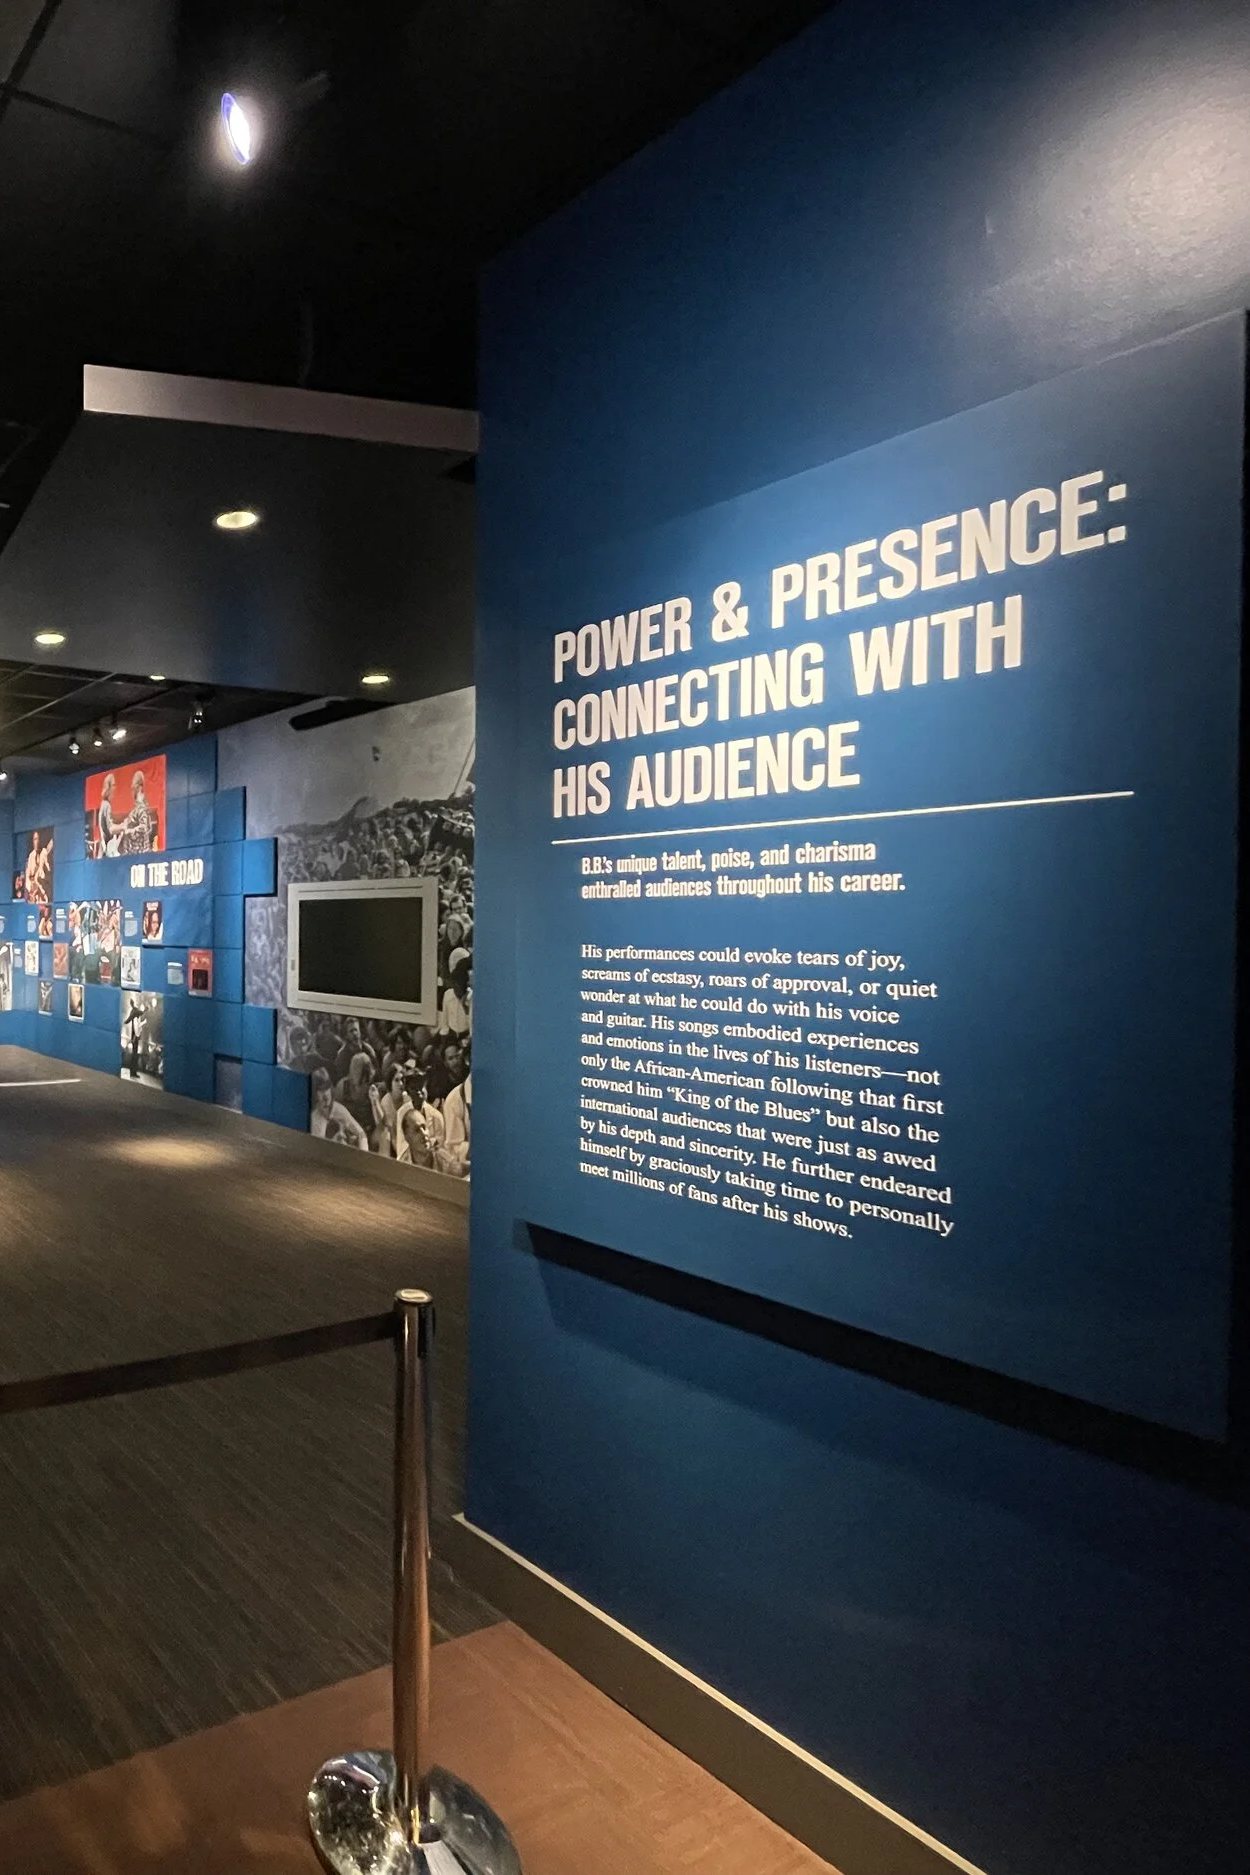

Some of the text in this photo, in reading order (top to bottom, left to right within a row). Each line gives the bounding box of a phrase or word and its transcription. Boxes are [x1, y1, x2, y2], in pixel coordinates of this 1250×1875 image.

[554, 470, 1128, 683] POWER & PRESENCE:
[554, 594, 1024, 750] CONNECTING WITH
[553, 721, 861, 818] HIS AUDIENCE
[131, 858, 204, 888] ON THE ROAD
[580, 872, 906, 899] enthralled audiences throughout his career.
[616, 854, 657, 874] unique
[661, 850, 706, 871] talent,
[711, 848, 754, 871] poise,
[760, 844, 789, 866] and
[795, 841, 876, 863] charisma
[582, 944, 905, 972] His performances could evoke tears of joy,
[582, 968, 938, 1000] screams of ecstasy, roars of approval, or quiet
[580, 989, 900, 1024] wonder at what he could do with his voice
[580, 1010, 919, 1055] and guitar. His songs embodied experiences
[580, 1032, 603, 1045] and
[606, 1036, 664, 1052] emotions
[668, 1040, 682, 1055] in
[686, 1042, 708, 1058] the
[714, 1044, 748, 1062] lives
[752, 1050, 772, 1065] of
[774, 1051, 800, 1068] his
[581, 1054, 944, 1114] only the African-American following that first
[581, 1077, 633, 1094] crowned
[636, 1082, 662, 1098] him
[714, 1095, 733, 1109] of
[734, 1097, 759, 1114] the
[826, 1110, 856, 1130] but
[861, 1117, 901, 1137] also
[908, 1123, 940, 1143] the
[580, 1094, 936, 1172] international audiences that were just as awed
[580, 1116, 952, 1204] by his depth and sincerity. He further endeared
[579, 1162, 852, 1238] meet millions of fans after his shows.
[580, 1137, 954, 1237] himself by graciously taking time to personally
